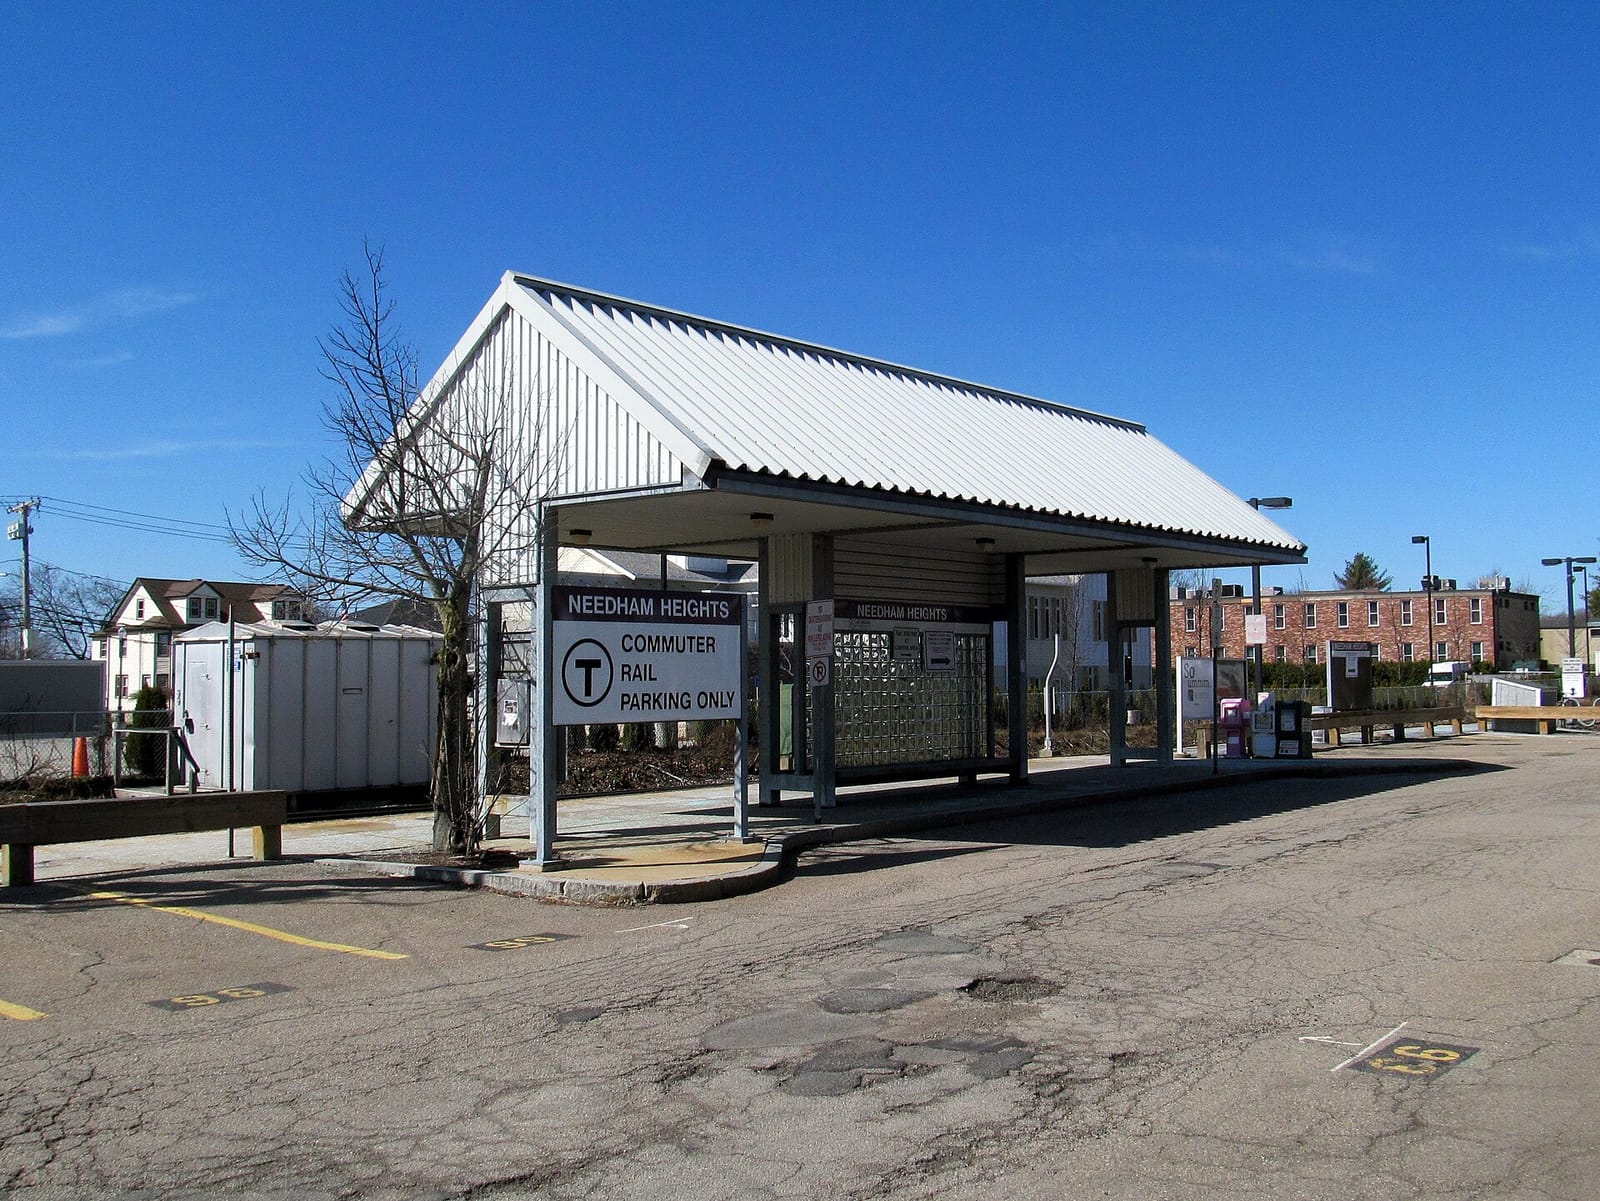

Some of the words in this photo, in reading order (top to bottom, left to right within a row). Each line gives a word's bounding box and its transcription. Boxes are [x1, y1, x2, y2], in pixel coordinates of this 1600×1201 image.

[568, 594, 654, 616] NEEDHAM
[660, 598, 730, 619] HEIGHTS
[857, 604, 905, 620] NEEDHAM
[907, 607, 948, 621] HEIGHTS
[621, 634, 716, 653] COMMUTER
[575, 658, 602, 697] T
[621, 663, 658, 682] RAIL
[620, 691, 692, 711] PARKING
[696, 691, 736, 709] ONLY
